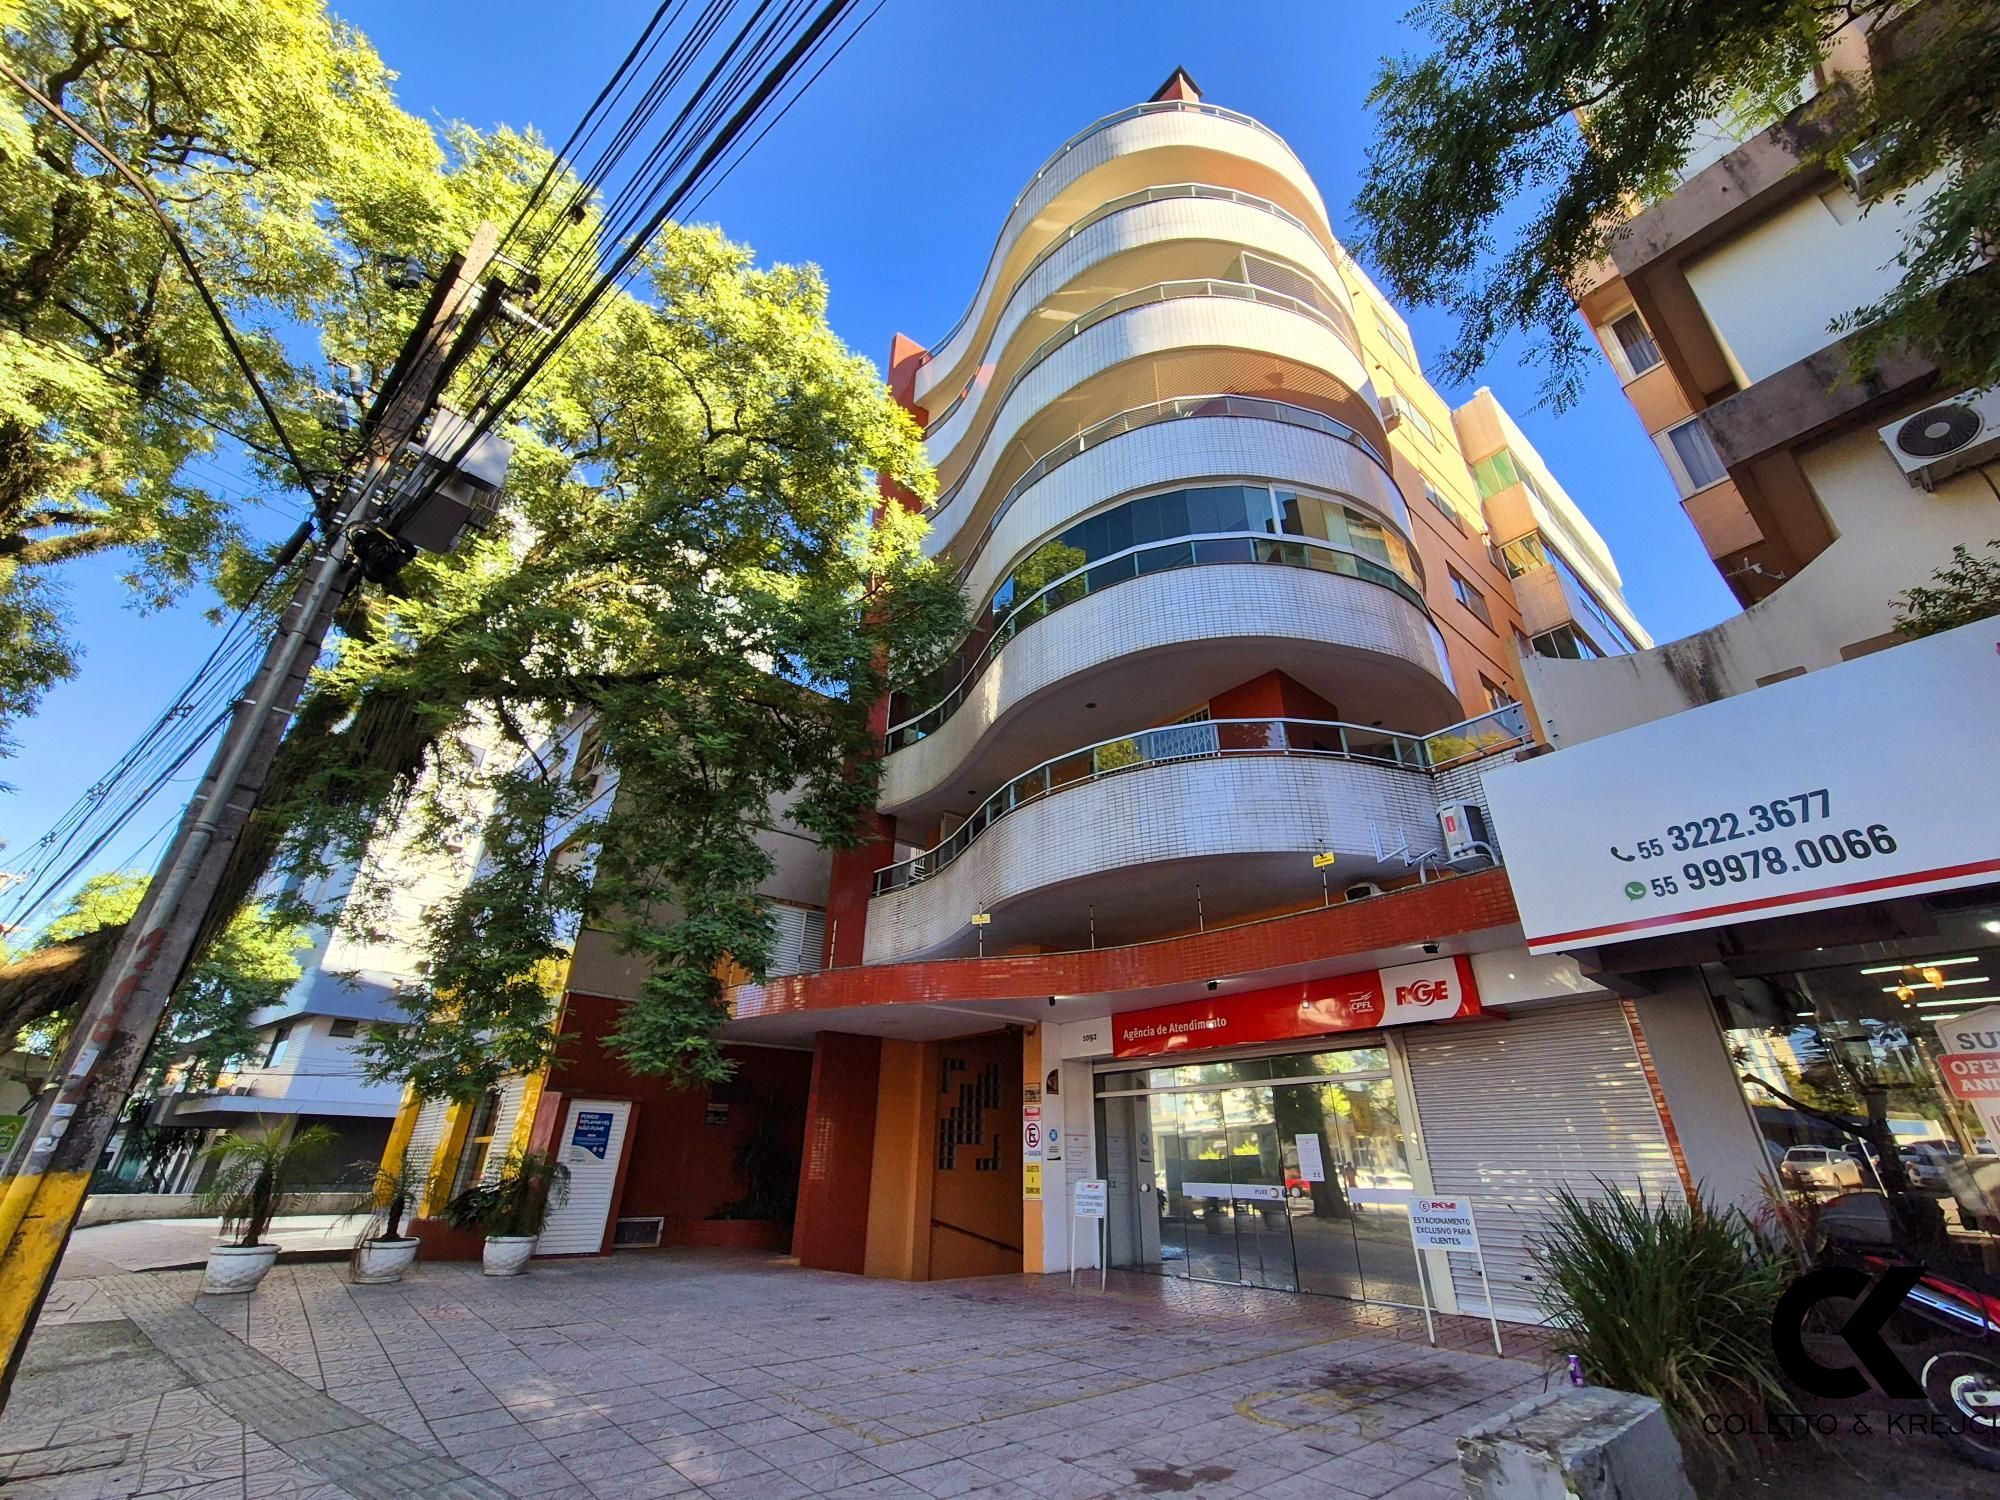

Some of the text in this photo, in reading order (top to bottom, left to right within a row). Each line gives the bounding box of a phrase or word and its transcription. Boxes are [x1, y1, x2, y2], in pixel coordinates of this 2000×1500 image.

[1637, 789, 1830, 859] 55 3222.3677
[1650, 824, 1897, 897] 55 99978.0066
[1396, 980, 1448, 1006] RGE
[1351, 1000, 1373, 1010] CPFL
[1123, 1017, 1227, 1041] Agência de Atendimento
[1956, 1031, 2000, 1050] SU
[1413, 1216, 1471, 1226] ESTACIONAMENTO
[1416, 1226, 1472, 1236] EXCLUSIVO PARA
[1430, 1236, 1461, 1246] CLIENTES
